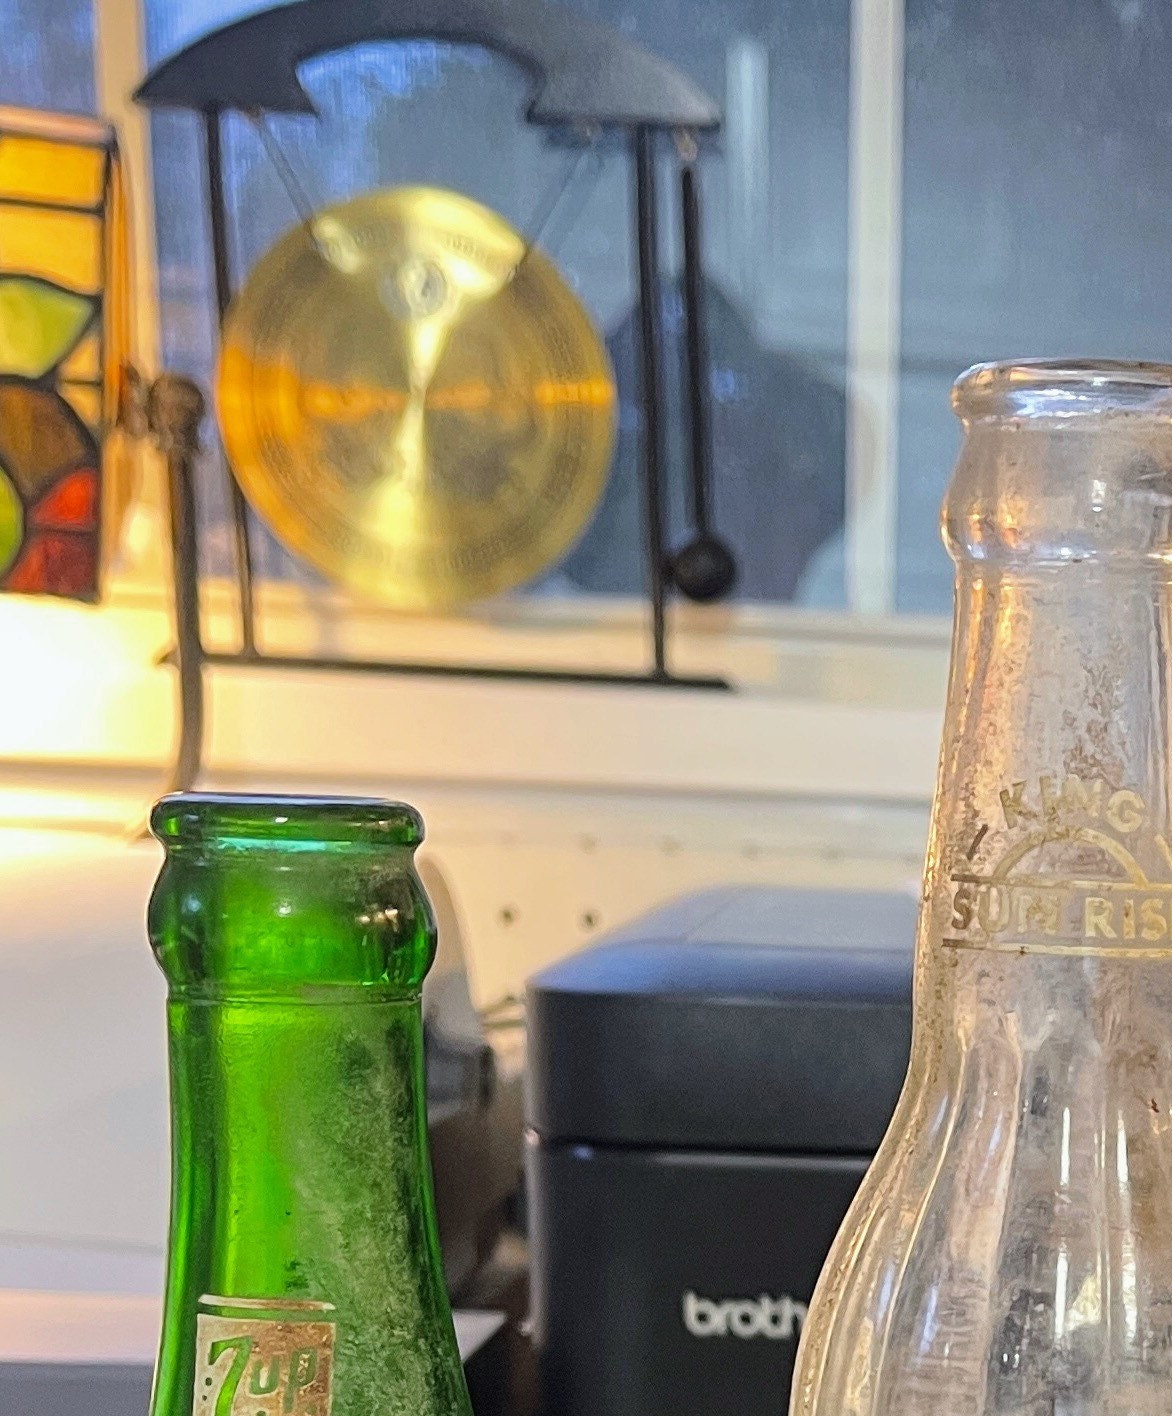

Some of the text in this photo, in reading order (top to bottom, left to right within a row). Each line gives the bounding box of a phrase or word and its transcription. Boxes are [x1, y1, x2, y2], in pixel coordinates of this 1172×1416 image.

[1000, 774, 1146, 833] KING
[951, 886, 1062, 935] SUN
[682, 1288, 809, 1340] broth
